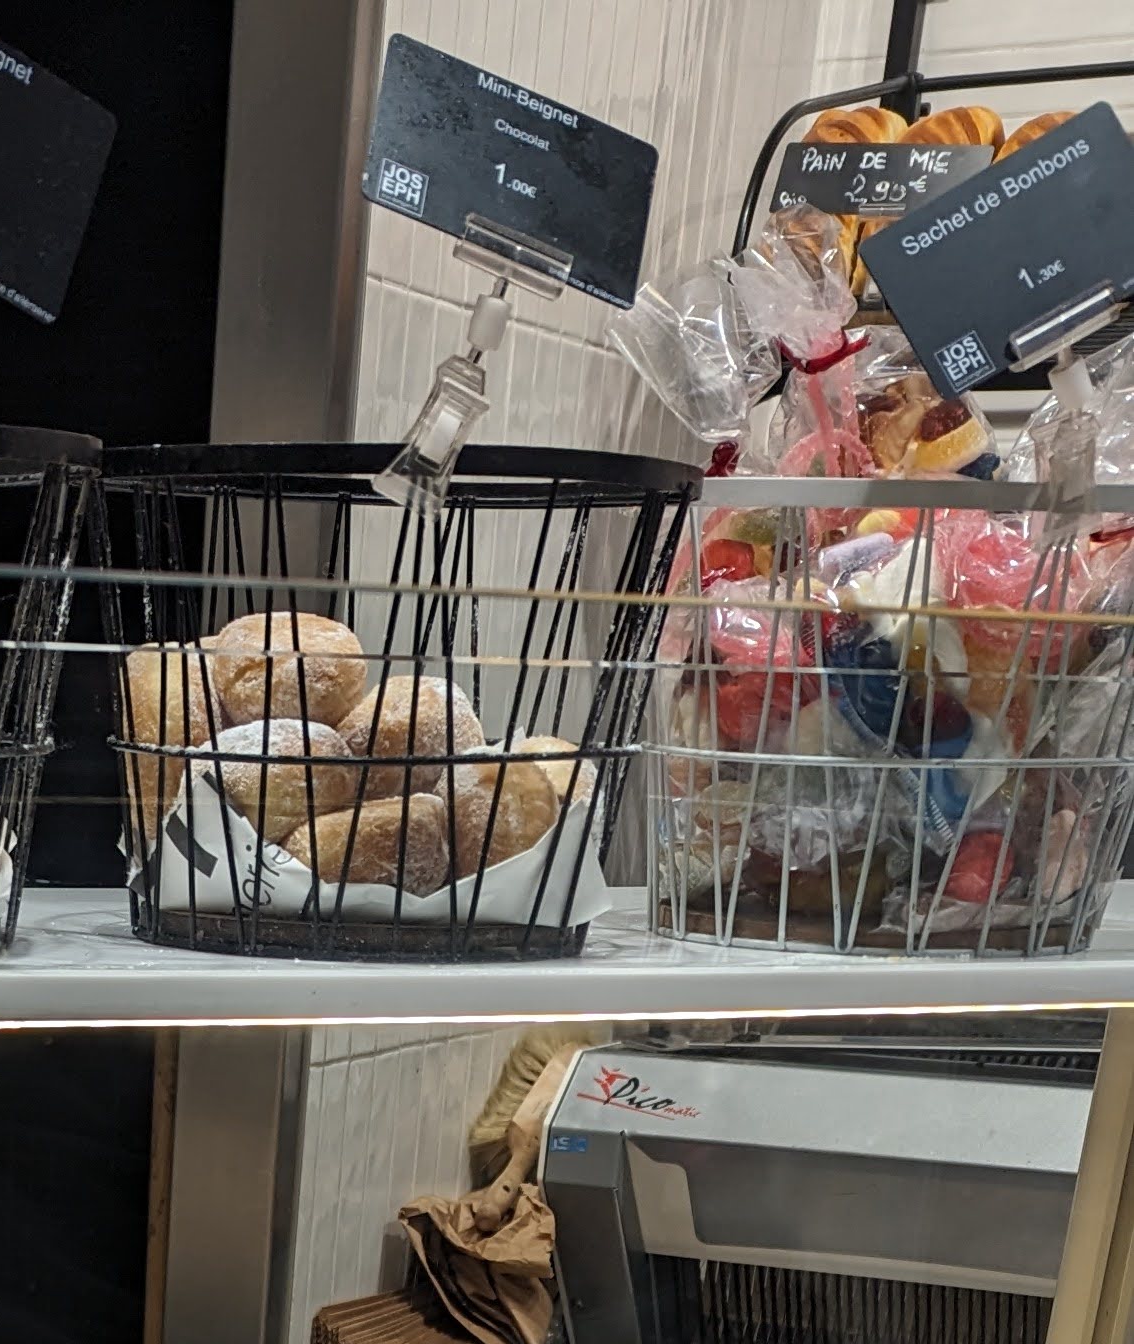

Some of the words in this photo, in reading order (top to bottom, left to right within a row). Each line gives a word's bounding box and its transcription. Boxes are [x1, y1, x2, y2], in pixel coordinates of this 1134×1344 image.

[477, 72, 579, 129] Mini-Beignet
[494, 117, 551, 152] Chocolat
[859, 151, 887, 170] DE
[383, 163, 423, 190] JOS
[495, 163, 537, 199] 1.00€
[381, 179, 421, 206] EPH
[901, 205, 973, 256] Sachet
[974, 190, 1002, 216] de
[1000, 138, 1090, 199] Bonbons
[1018, 259, 1066, 289] 1.30€
[943, 336, 979, 367] JOS
[946, 351, 986, 382] EPH
